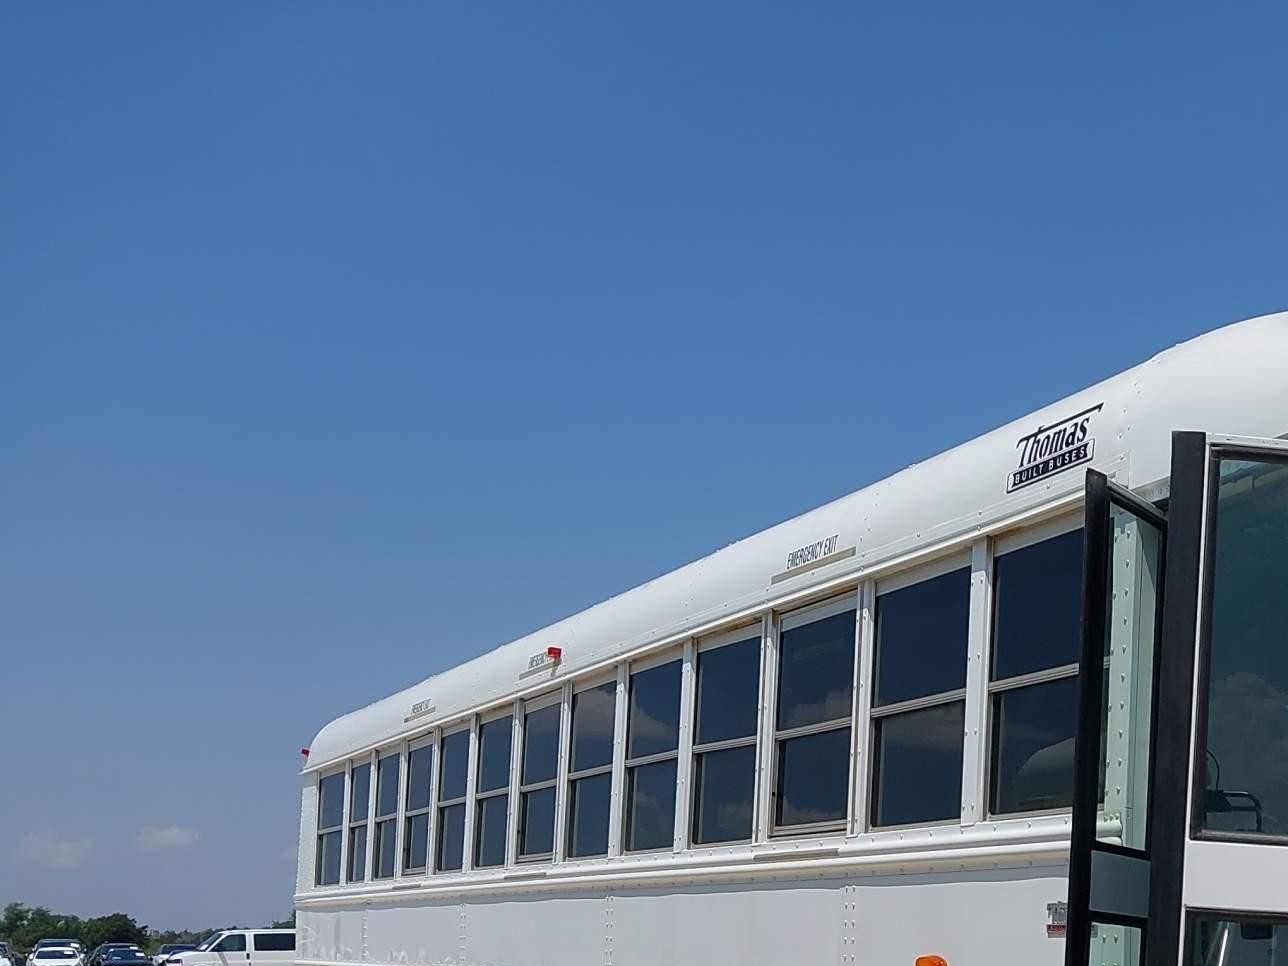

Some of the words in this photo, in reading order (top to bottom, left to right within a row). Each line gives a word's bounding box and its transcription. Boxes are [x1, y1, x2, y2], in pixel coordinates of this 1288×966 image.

[1016, 402, 1104, 468] Thomas
[1014, 463, 1044, 484] BUILT
[1048, 446, 1085, 473] BUSES
[786, 540, 825, 570] EMERGENCY
[824, 534, 839, 556] EXIT
